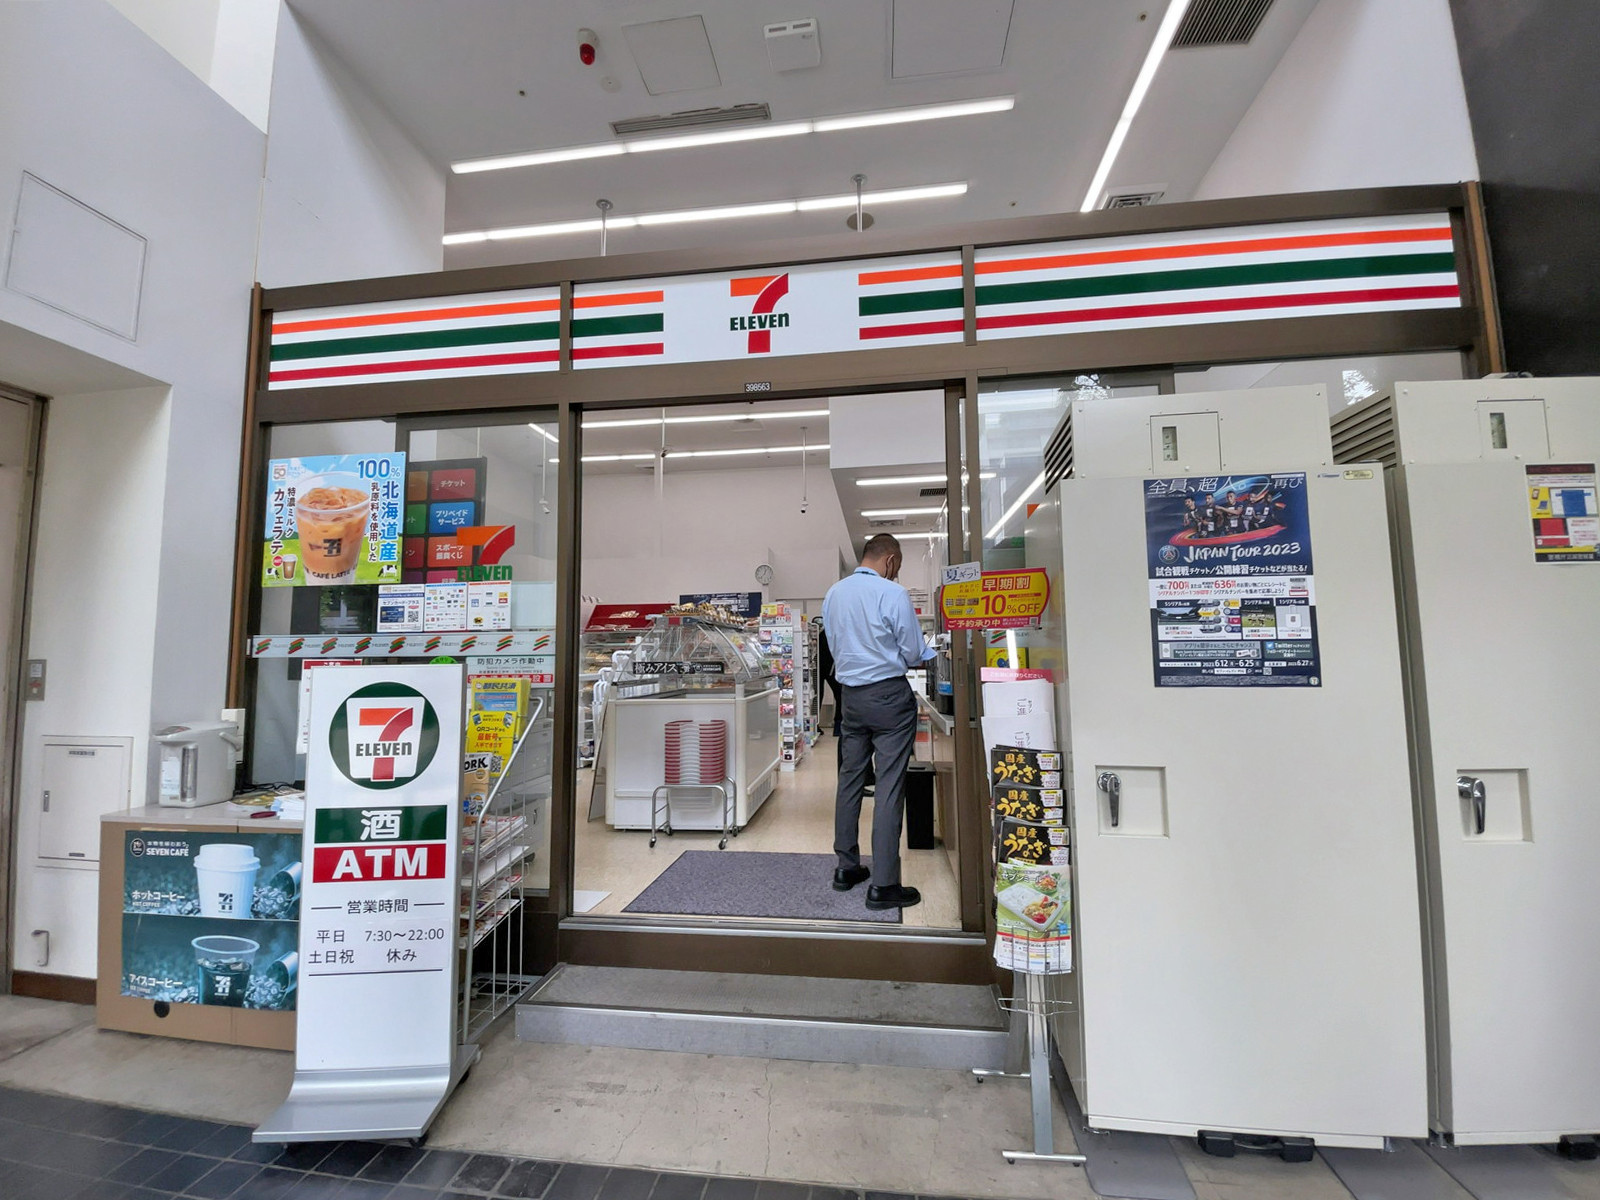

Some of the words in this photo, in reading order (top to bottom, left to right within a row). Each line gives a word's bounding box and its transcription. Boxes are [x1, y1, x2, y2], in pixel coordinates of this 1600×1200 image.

[730, 273, 789, 354] 7
[745, 382, 771, 392] 398563
[1148, 476, 1246, 495] 全員、超人。
[285, 487, 296, 537] 特濃ミルク
[270, 488, 285, 554] カフェラテ
[368, 482, 380, 561] 乳原料を使用した
[379, 481, 399, 561] 北海道産
[1184, 545, 1227, 562] JAPAN
[1227, 544, 1261, 562] TOUR
[1261, 542, 1301, 556] 2023
[983, 576, 1030, 591] 早期割
[948, 620, 1000, 628] ご予約承り中
[477, 657, 545, 665] 防犯カメラ作動中
[359, 707, 413, 780] 7
[1005, 753, 1026, 764] 国産
[994, 761, 1038, 783] うなぎ
[1008, 790, 1029, 801] 国産
[997, 797, 1041, 820] うなぎ
[360, 810, 402, 841] 酒
[1016, 827, 1038, 838] 国産
[146, 848, 169, 856] SEVEN
[1003, 834, 1047, 859] うなぎ
[332, 847, 428, 880] ATM
[132, 890, 185, 902] ホットコーヒー
[347, 899, 409, 914] 営業時間
[316, 930, 345, 943] 平日
[308, 949, 354, 964] 土日祝
[386, 949, 417, 963] 休み
[129, 973, 183, 987] アイスコーヒー
